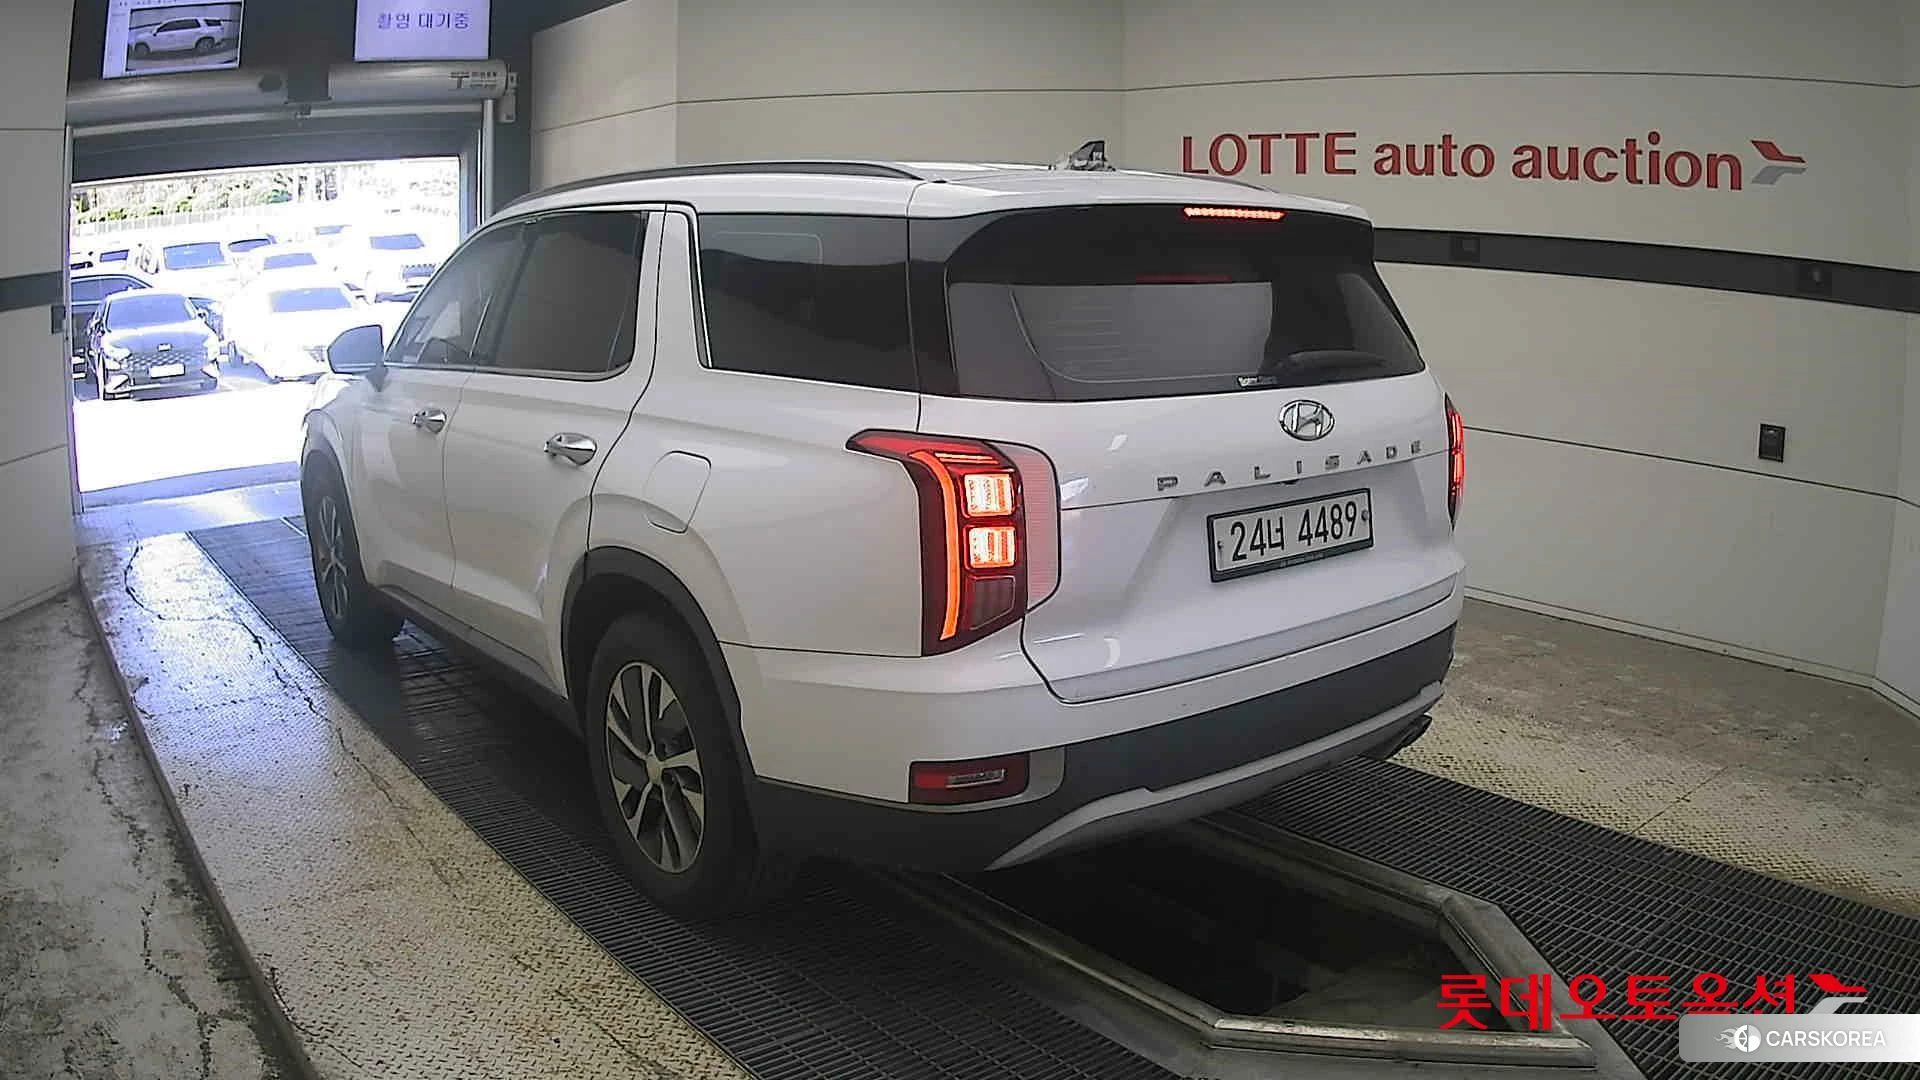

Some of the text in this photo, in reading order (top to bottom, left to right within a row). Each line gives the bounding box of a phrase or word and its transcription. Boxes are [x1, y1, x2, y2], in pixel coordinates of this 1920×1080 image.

[418, 12, 470, 29] 대기중
[1183, 131, 1742, 190] LOTTE auto auction
[1157, 440, 1421, 491] PALISADE
[1230, 501, 1358, 562] 24너 4489
